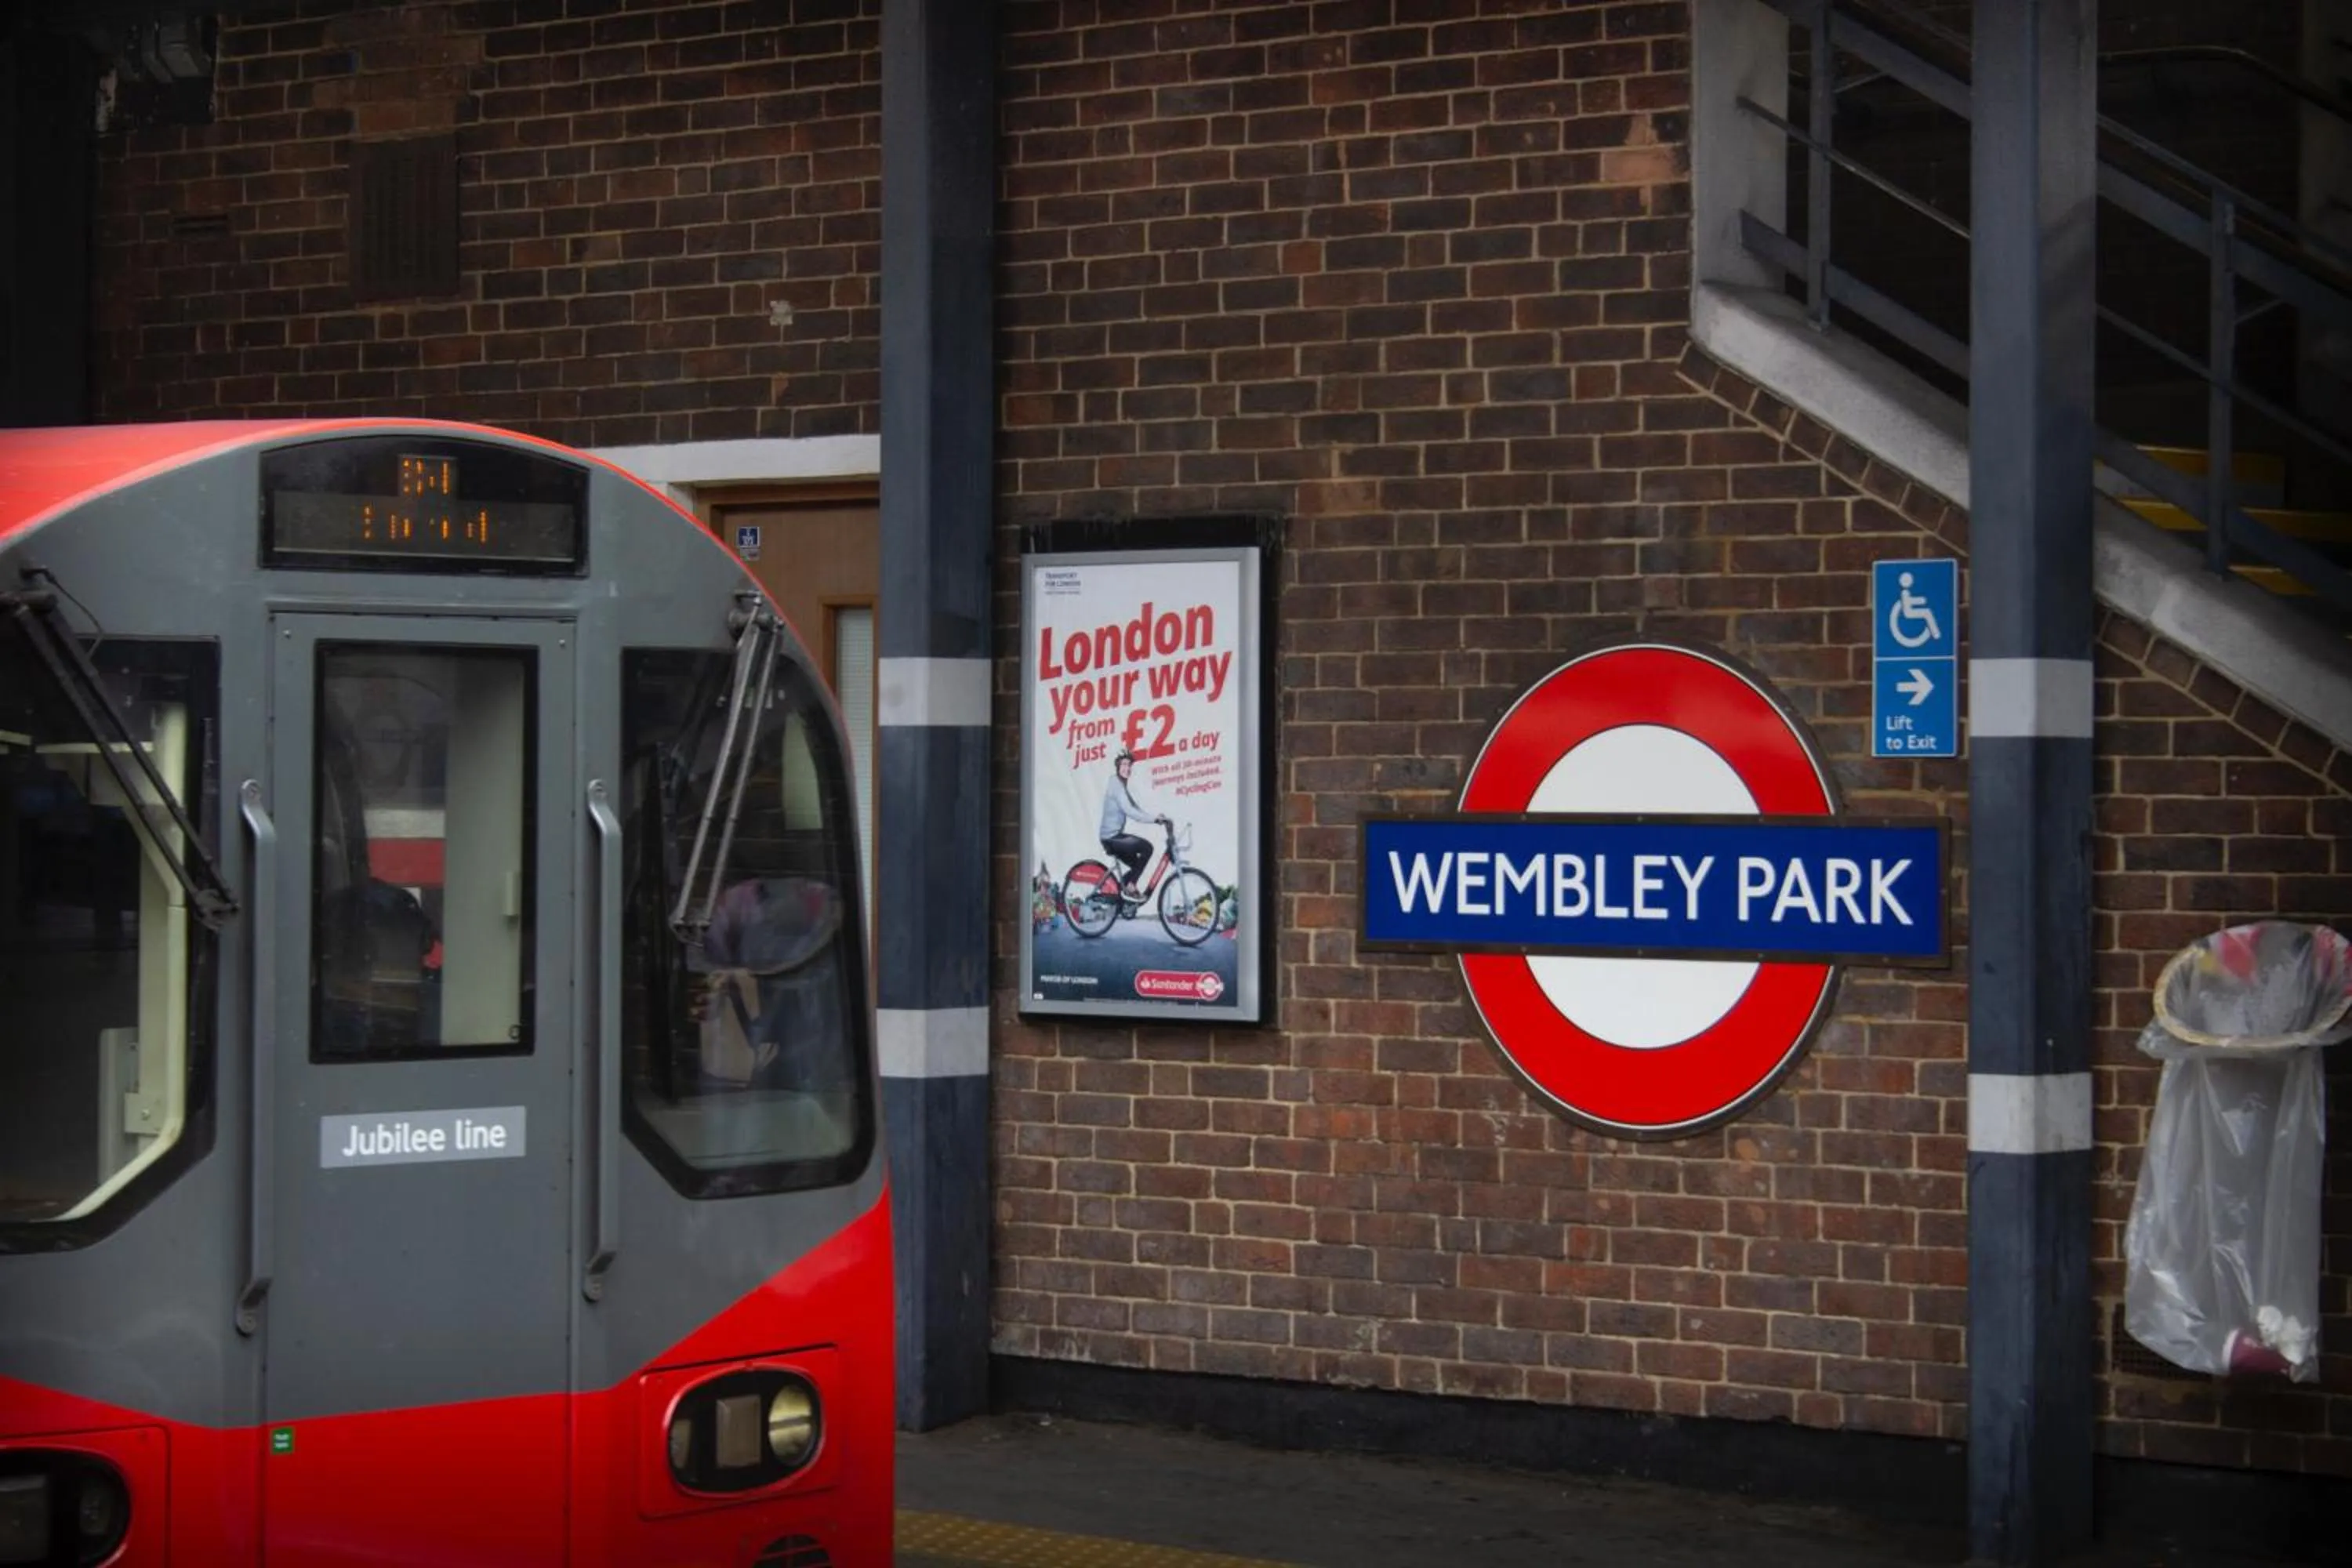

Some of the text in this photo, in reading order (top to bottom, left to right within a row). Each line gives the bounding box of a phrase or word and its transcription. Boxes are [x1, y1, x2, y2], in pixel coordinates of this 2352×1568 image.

[1040, 601, 1214, 681] London
[1049, 651, 1232, 734] your way
[1066, 718, 1115, 749] from
[1121, 704, 1220, 762] £2 a day
[1886, 715, 1913, 731] Lift
[1073, 742, 1106, 769] just
[1886, 735, 1936, 750] to Exit
[1152, 764, 1169, 775] With
[1171, 761, 1181, 771] all
[1152, 774, 1185, 790] journeys
[1388, 851, 1914, 925] WEMBLEY PARK
[1151, 978, 1193, 991] Santander
[343, 1119, 506, 1156] Jubilee line
